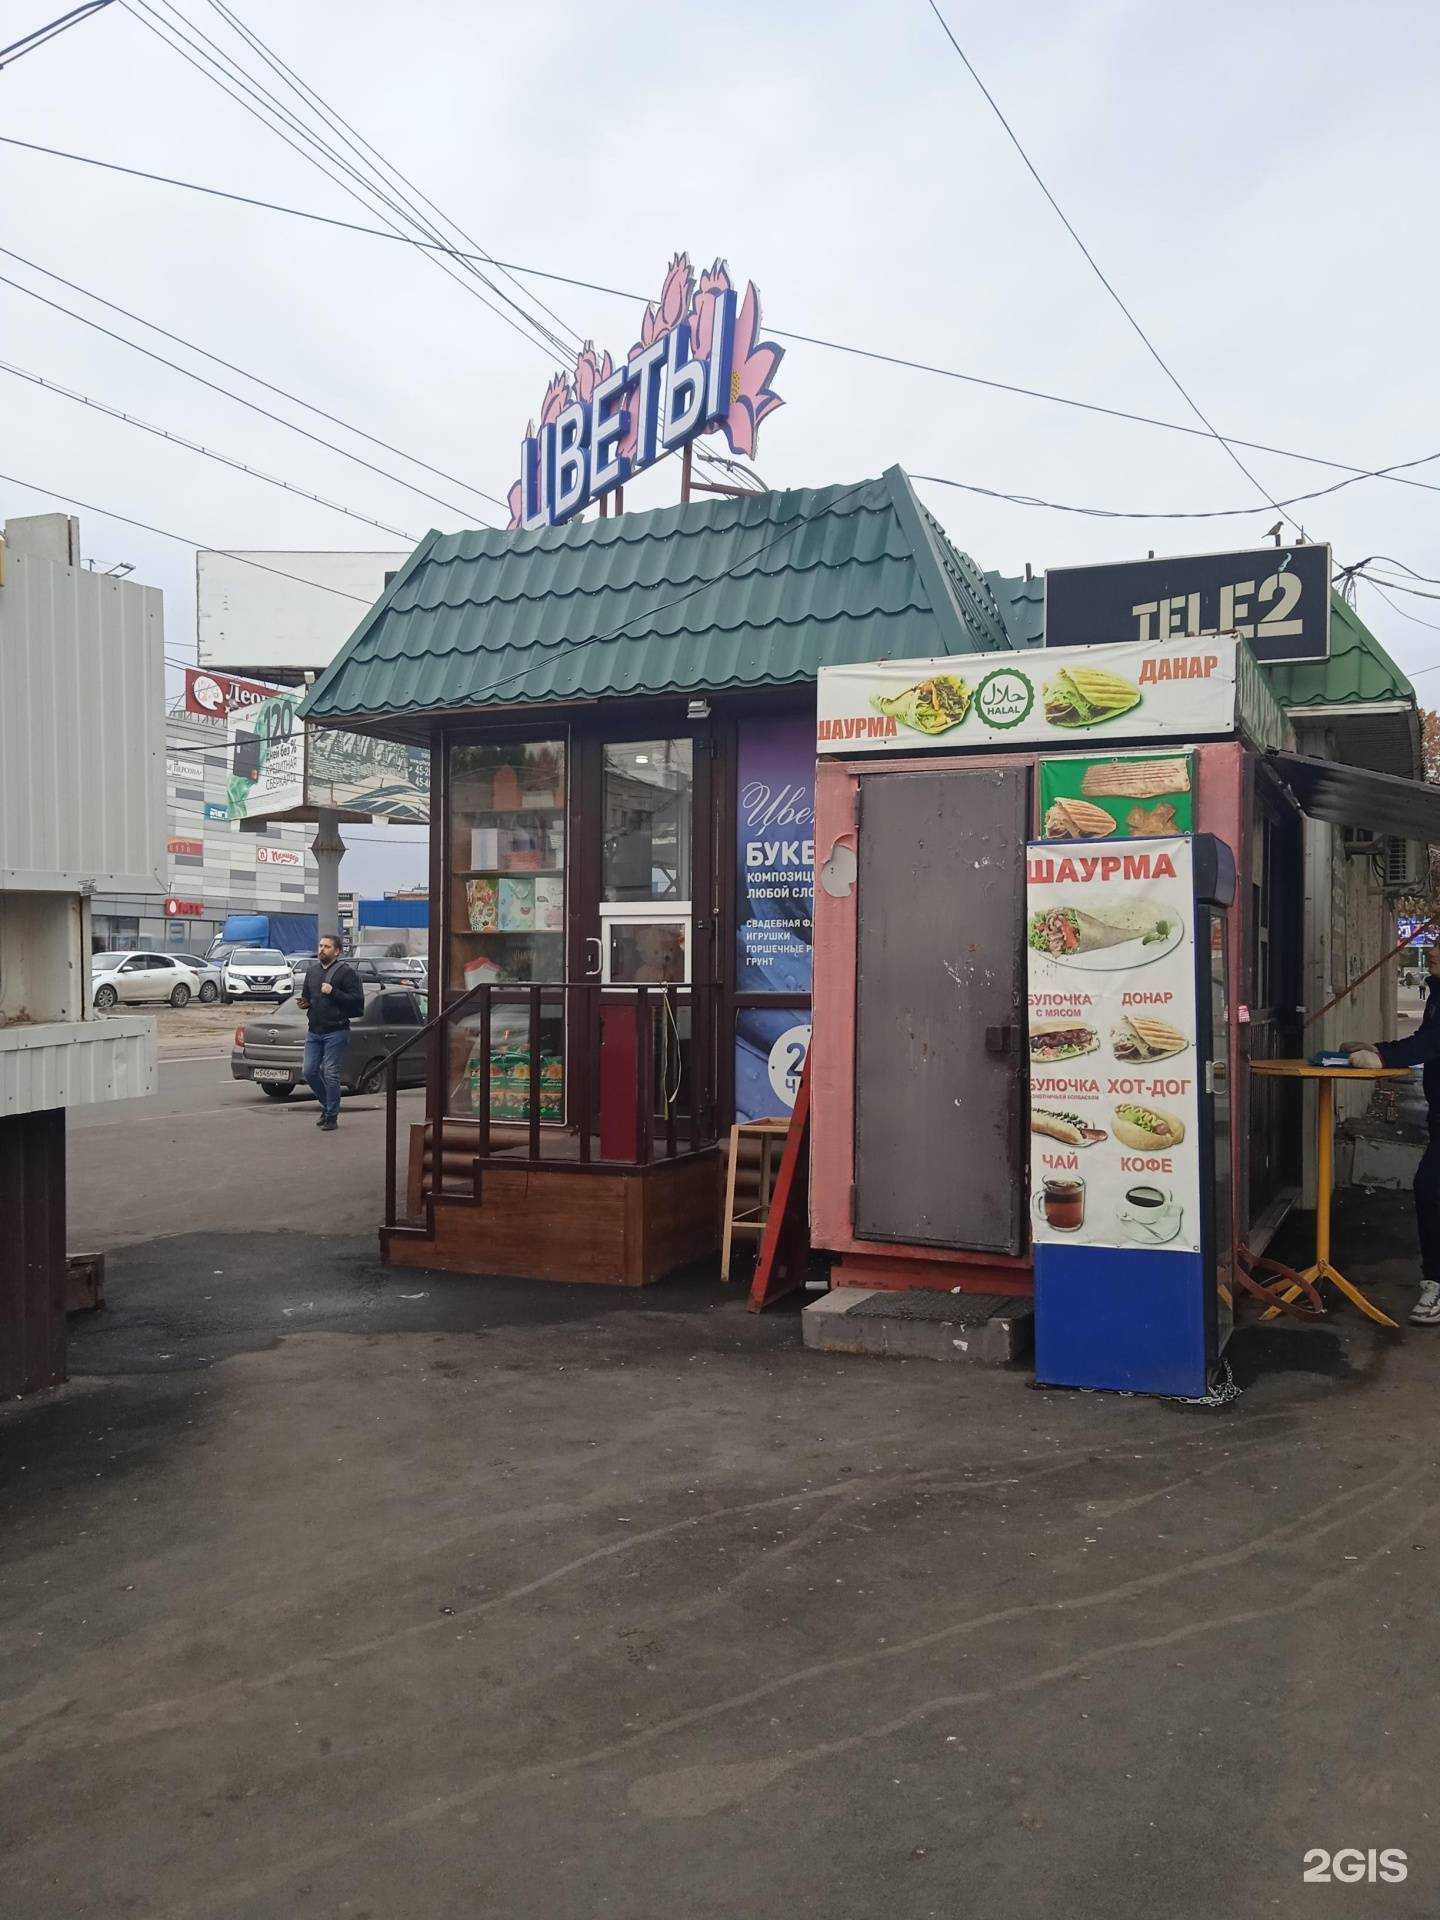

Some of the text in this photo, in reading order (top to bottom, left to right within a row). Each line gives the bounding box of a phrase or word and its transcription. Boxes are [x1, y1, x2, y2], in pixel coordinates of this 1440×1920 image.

[1132, 572, 1303, 641] TELE2
[1139, 655, 1218, 685] ДАНАР
[983, 683, 1025, 705] حلال
[988, 706, 1020, 715] HALAL
[264, 701, 292, 749] 120
[742, 782, 815, 836] Цве
[746, 840, 815, 867] БУКЕ
[1027, 853, 1177, 884] ШАУРМА
[746, 885, 789, 898] ЛЮБОЙ
[746, 919, 801, 929] СВАДЕБНАЯ
[746, 932, 790, 941] ИГРУШКИ
[746, 944, 804, 954] ГОРШЕЧНЫЕ
[746, 957, 775, 966] ГРУНТ
[1121, 991, 1174, 1007] ДОНАР
[1035, 1008, 1082, 1018] С МЯСОМ
[1107, 1078, 1192, 1098] ХОТ-ДОГ
[1042, 1151, 1173, 1174] ЧАЙ КОФЕ
